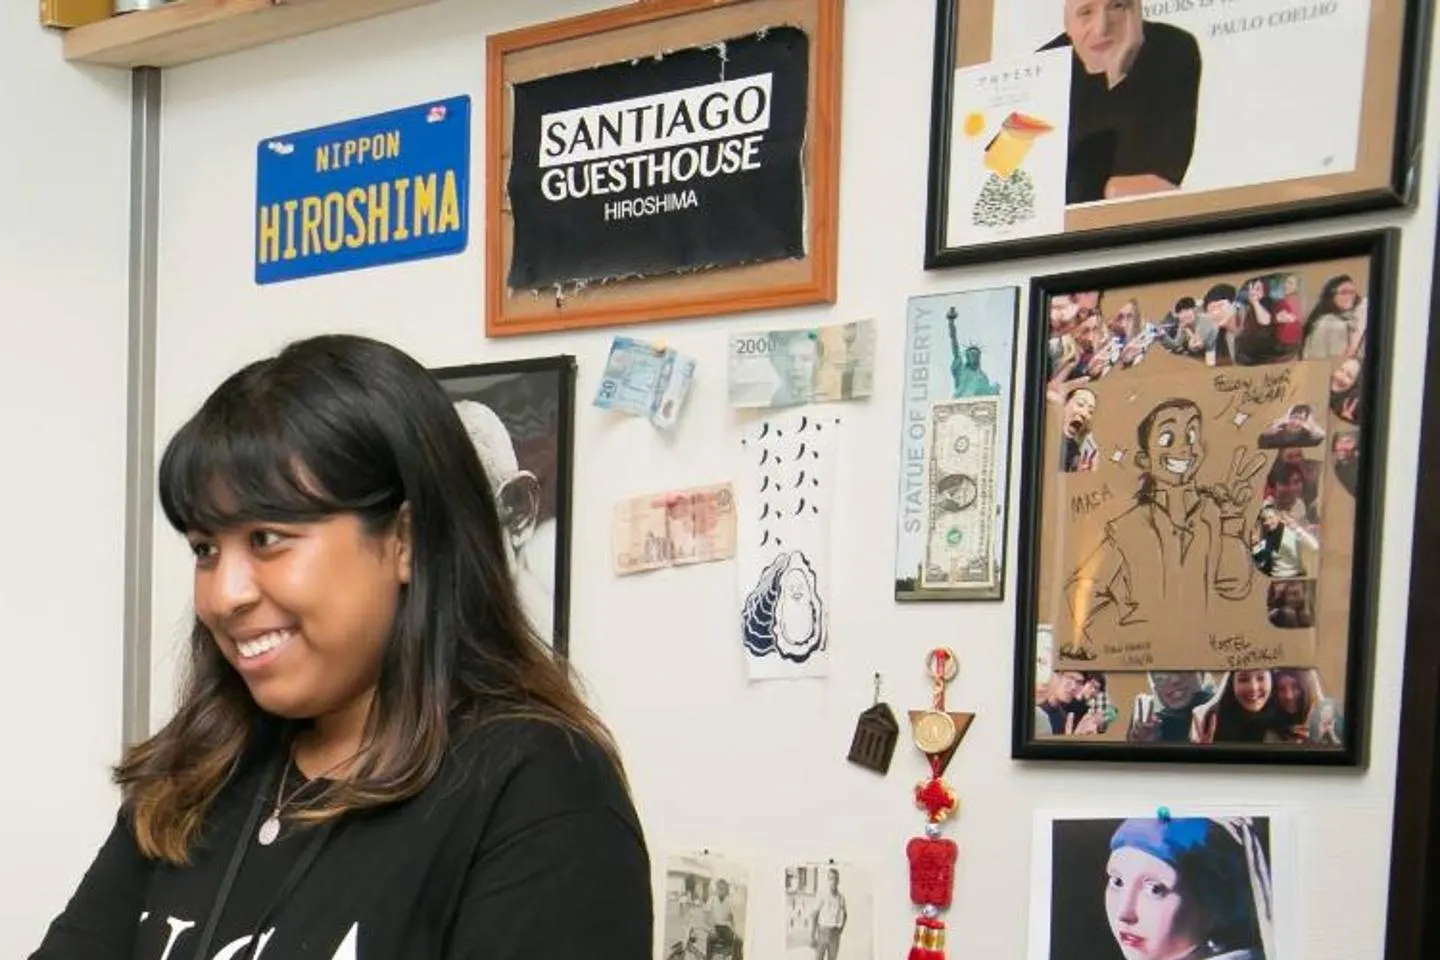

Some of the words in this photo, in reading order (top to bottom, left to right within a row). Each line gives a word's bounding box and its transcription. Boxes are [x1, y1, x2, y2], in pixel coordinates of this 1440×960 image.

[1210, 14, 1263, 37] PAULO
[1267, 2, 1337, 27] COELHO
[316, 131, 400, 173] NIPPON
[545, 85, 767, 158] SANTIAGO
[540, 136, 762, 201] GUESTHOUSE
[260, 170, 460, 264] HIROSHIMA
[604, 190, 698, 222] HIROSHIMA
[911, 308, 933, 401] LIBERTY
[910, 409, 926, 441] OF
[905, 448, 924, 534] STATUE
